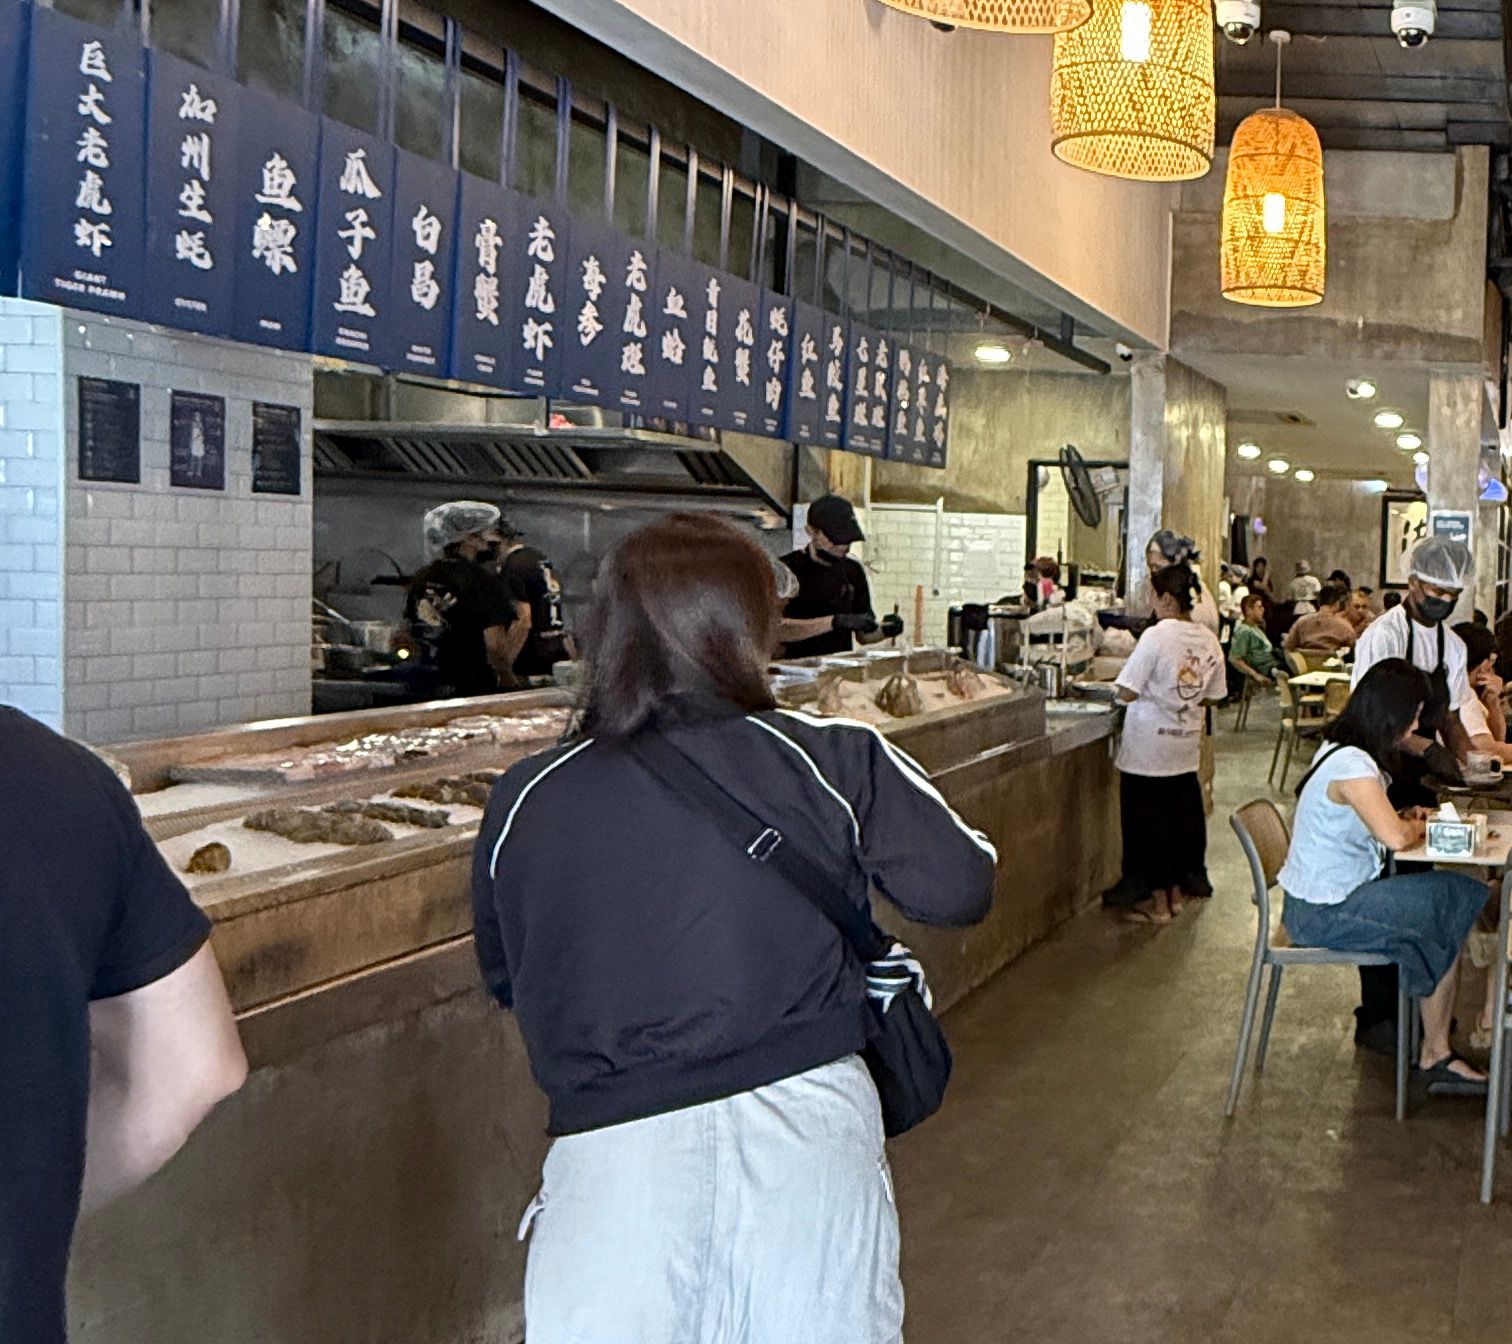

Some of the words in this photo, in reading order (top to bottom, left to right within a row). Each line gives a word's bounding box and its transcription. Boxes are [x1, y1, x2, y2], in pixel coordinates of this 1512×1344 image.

[75, 40, 113, 258] 巨大老虎虾
[175, 83, 217, 270] 加州生蚝
[410, 204, 442, 311] 白昌
[523, 215, 556, 361] 老虎虾
[578, 256, 607, 346] 海参
[620, 250, 648, 375] 老虎斑
